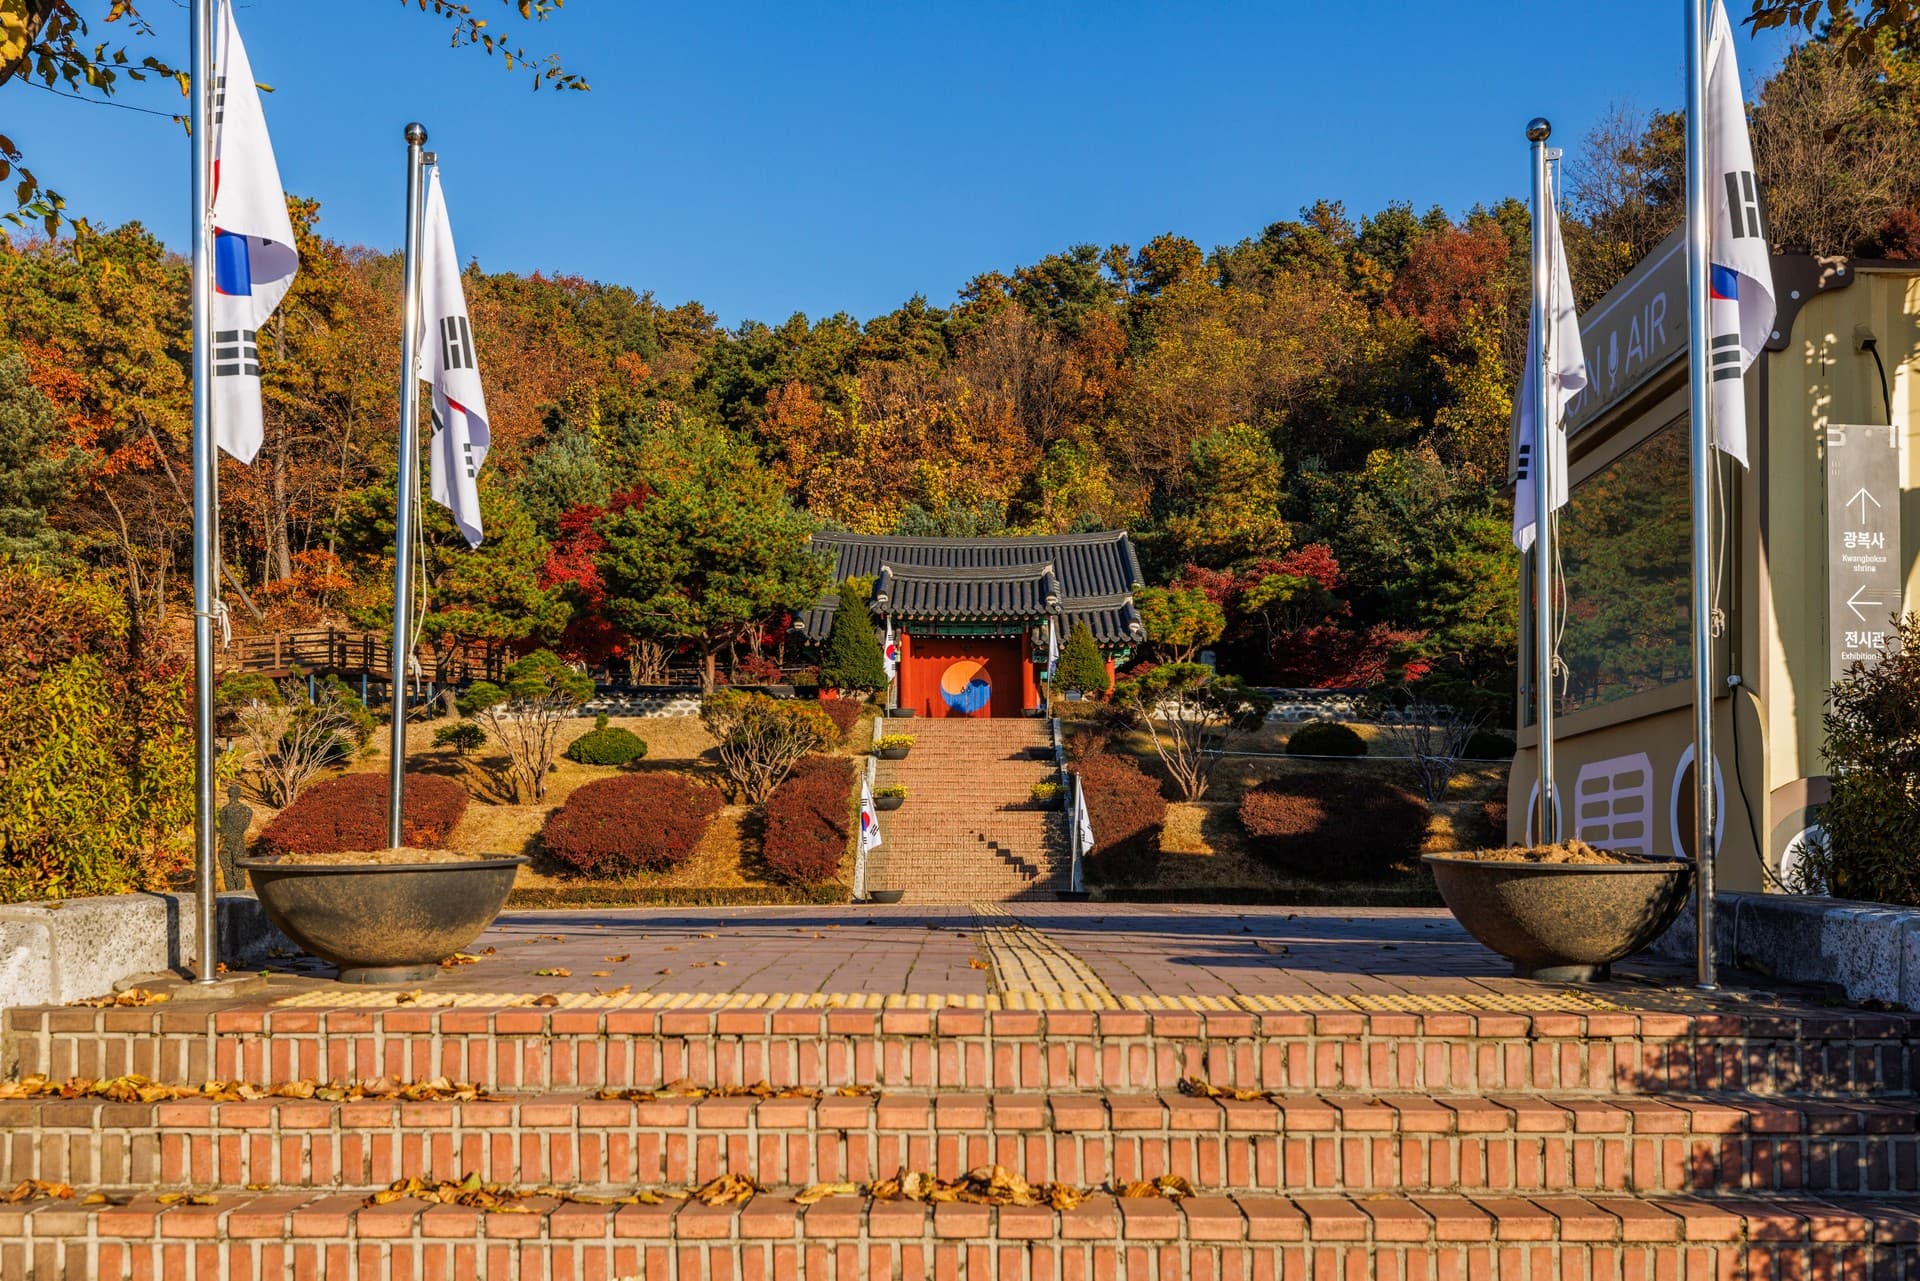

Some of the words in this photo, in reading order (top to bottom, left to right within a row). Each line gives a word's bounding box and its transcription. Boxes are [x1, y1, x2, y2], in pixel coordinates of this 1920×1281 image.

[1625, 291, 1666, 374] AIR
[1843, 531, 1885, 549] 광복사
[1842, 554, 1887, 564] Kwangboksa
[1853, 563, 1876, 572] shrine
[1845, 631, 1885, 648] 전시관
[1841, 651, 1877, 660] Exhibition
